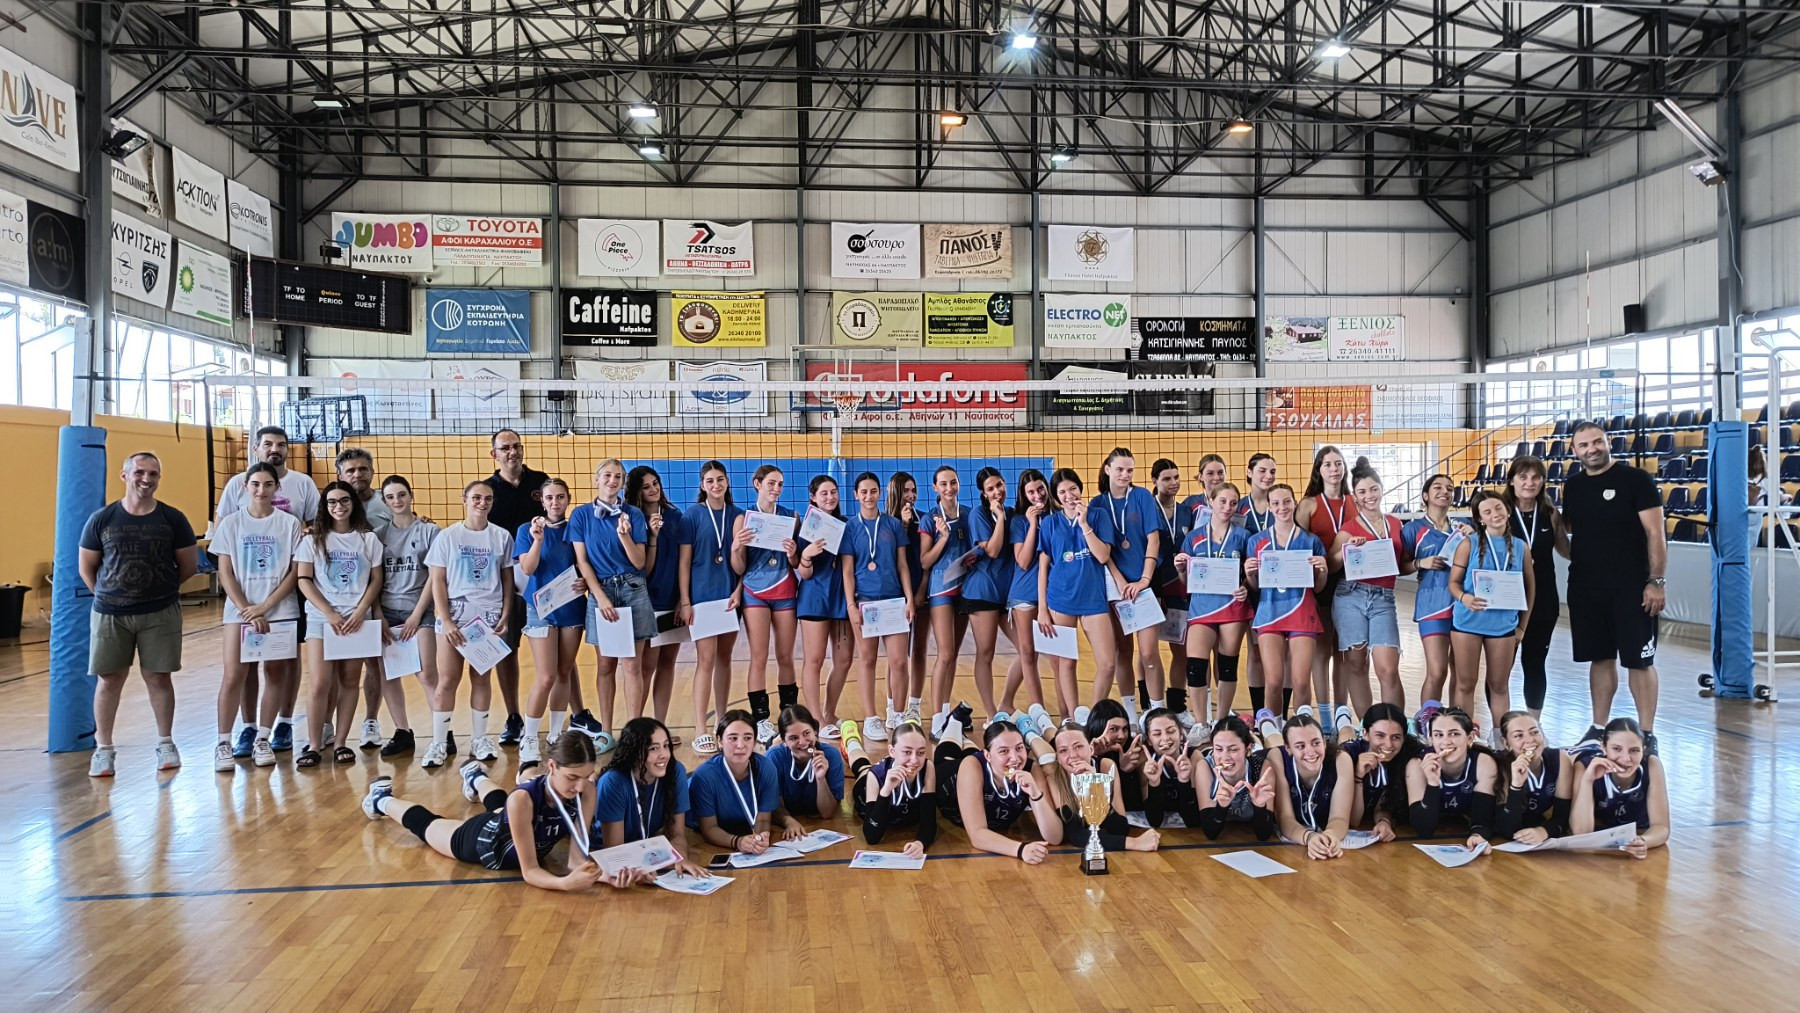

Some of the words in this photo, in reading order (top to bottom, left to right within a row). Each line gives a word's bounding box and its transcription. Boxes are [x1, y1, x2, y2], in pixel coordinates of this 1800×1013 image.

[467, 219, 539, 233] TOYOTA
[112, 221, 167, 260] ΚΥΡΙΤΣΗΣ
[335, 220, 428, 249] JUMBO
[441, 236, 463, 244] ΑΦΟΙ
[464, 237, 517, 245] ΚΑΡΑΧΑΛΙΟΥ
[608, 246, 628, 254] Piece
[687, 245, 736, 255] TSATSOS
[940, 233, 992, 255] ΠΑΝΟΣ
[285, 294, 306, 302] HOME
[318, 296, 343, 305] PERIOD
[356, 293, 365, 301] TO
[953, 297, 987, 305] Αθανάσιος
[354, 301, 376, 309] GUEST
[569, 295, 652, 324] Caffeine
[467, 312, 525, 320] ΕΚΠΑΙΔΕΥΤΗΡΙΑ
[1047, 308, 1102, 321] ELECTRO
[1105, 310, 1125, 320] NET
[1199, 320, 1247, 332] ΚΟΣΜΗΜΑΤΑ
[1337, 317, 1396, 330] ΞΕΝΙΟΣ
[1047, 333, 1097, 341] ΝΑΥΠΑΚΤΟΣ
[1148, 337, 1205, 348] ΚΑΤΣΙΓΙΑΝΝΗΣ
[1212, 337, 1247, 348] ΠΑΥΛΟΣ
[909, 411, 947, 423] Αθηνών
[947, 412, 958, 420] 11
[964, 411, 1015, 423] Ναύπακτος
[1265, 412, 1367, 428] ΤΣΟΥΚΑΛΑΣ
[900, 803, 909, 814] 3
[1444, 796, 1458, 809] 14
[995, 806, 1009, 820] 12
[545, 824, 560, 837] 11
